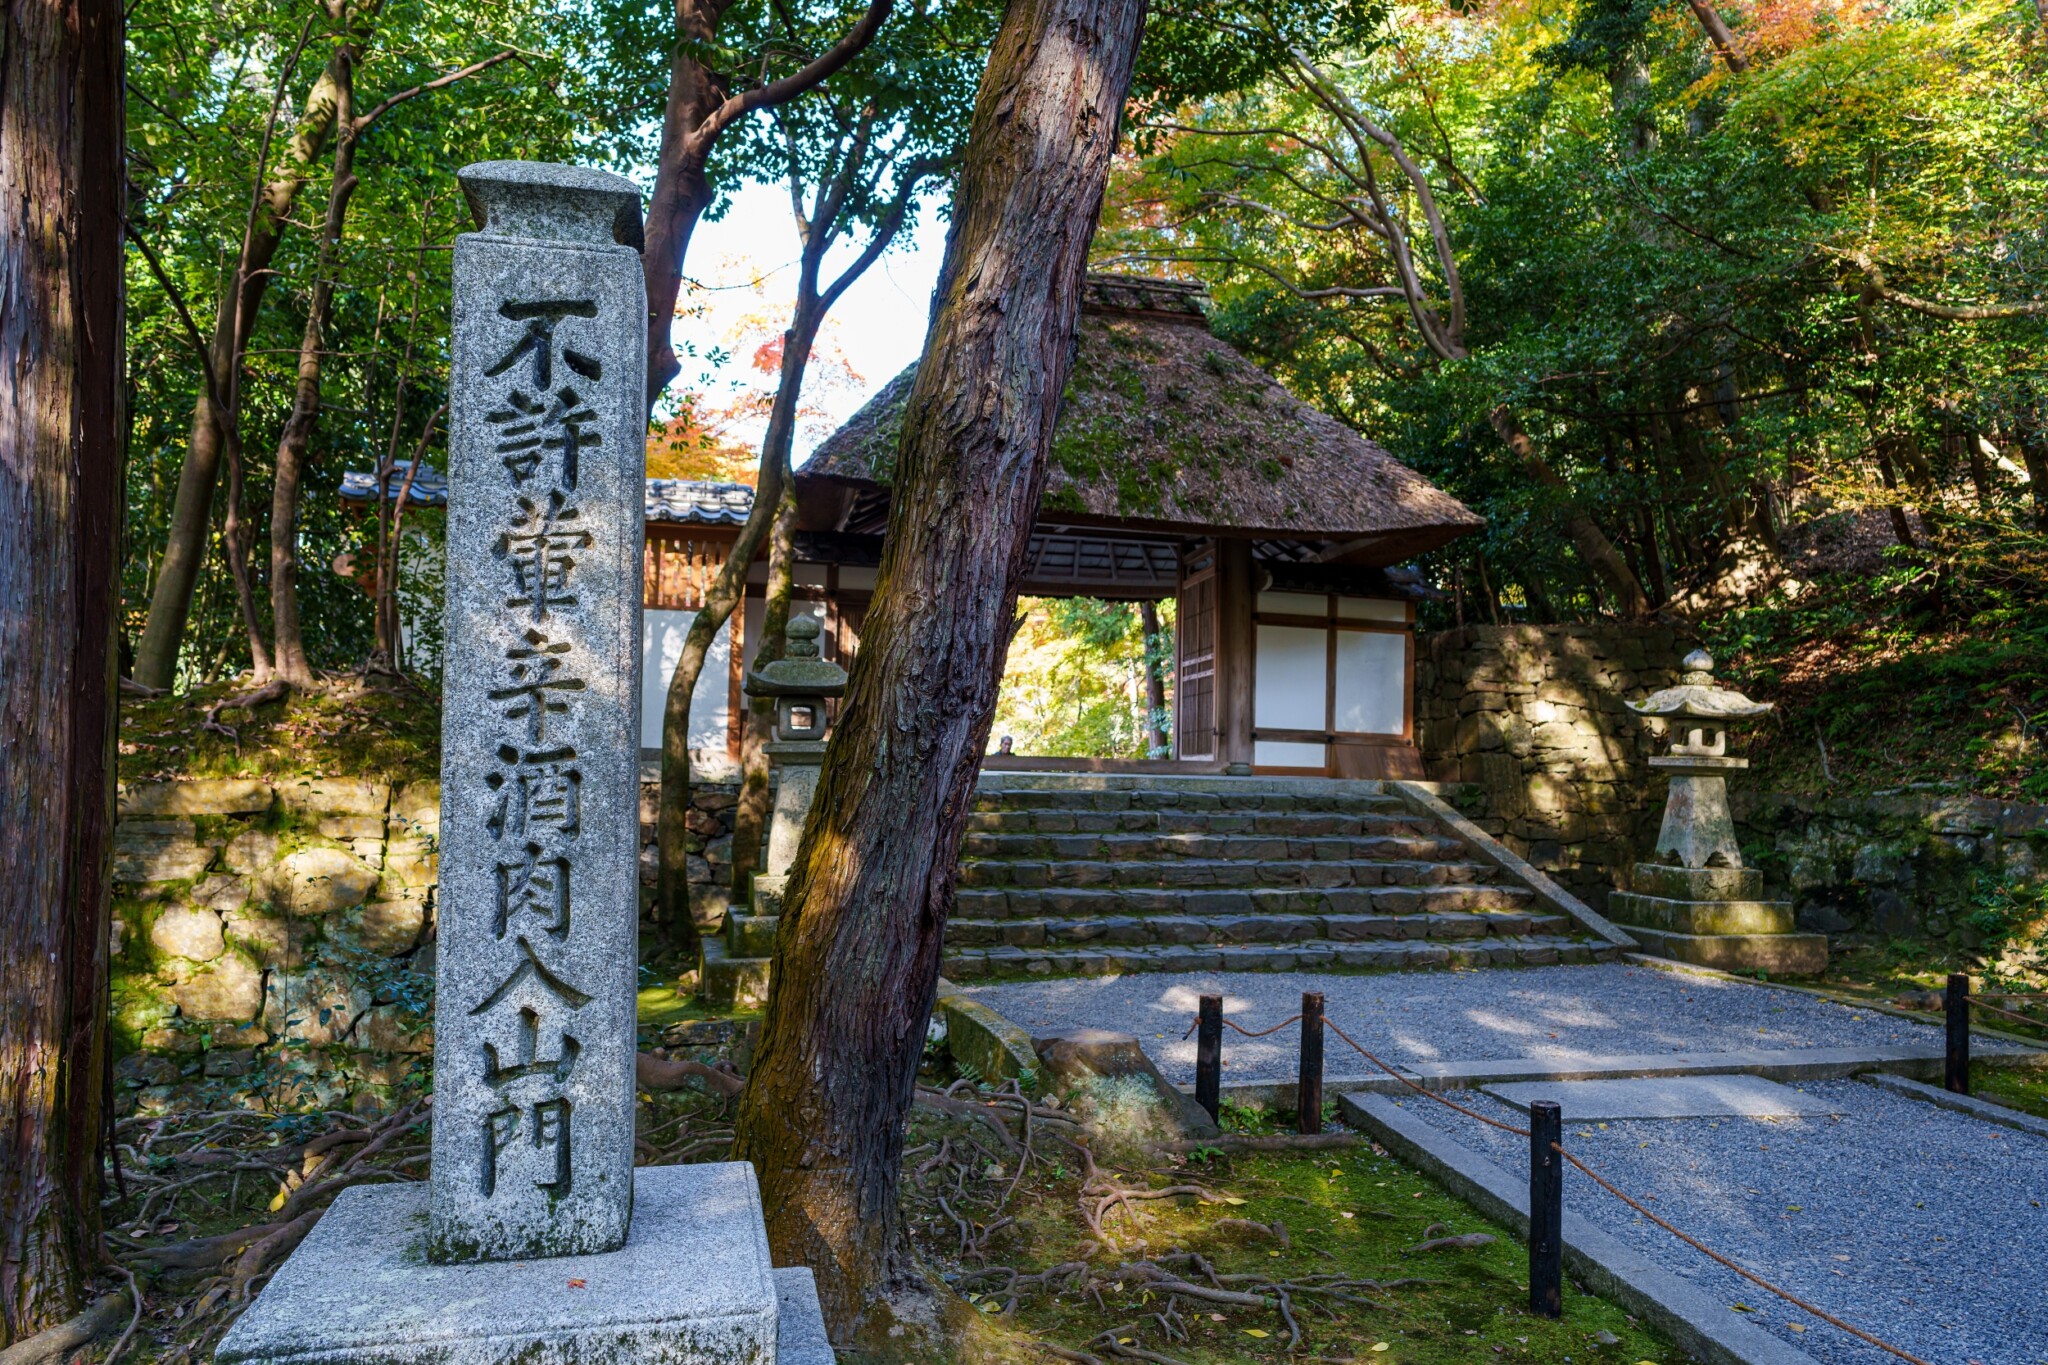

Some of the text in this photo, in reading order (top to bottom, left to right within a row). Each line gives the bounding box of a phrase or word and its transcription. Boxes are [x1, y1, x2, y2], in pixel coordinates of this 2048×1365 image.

[470, 300, 602, 1200] 不許葷辛酒肉入山門
